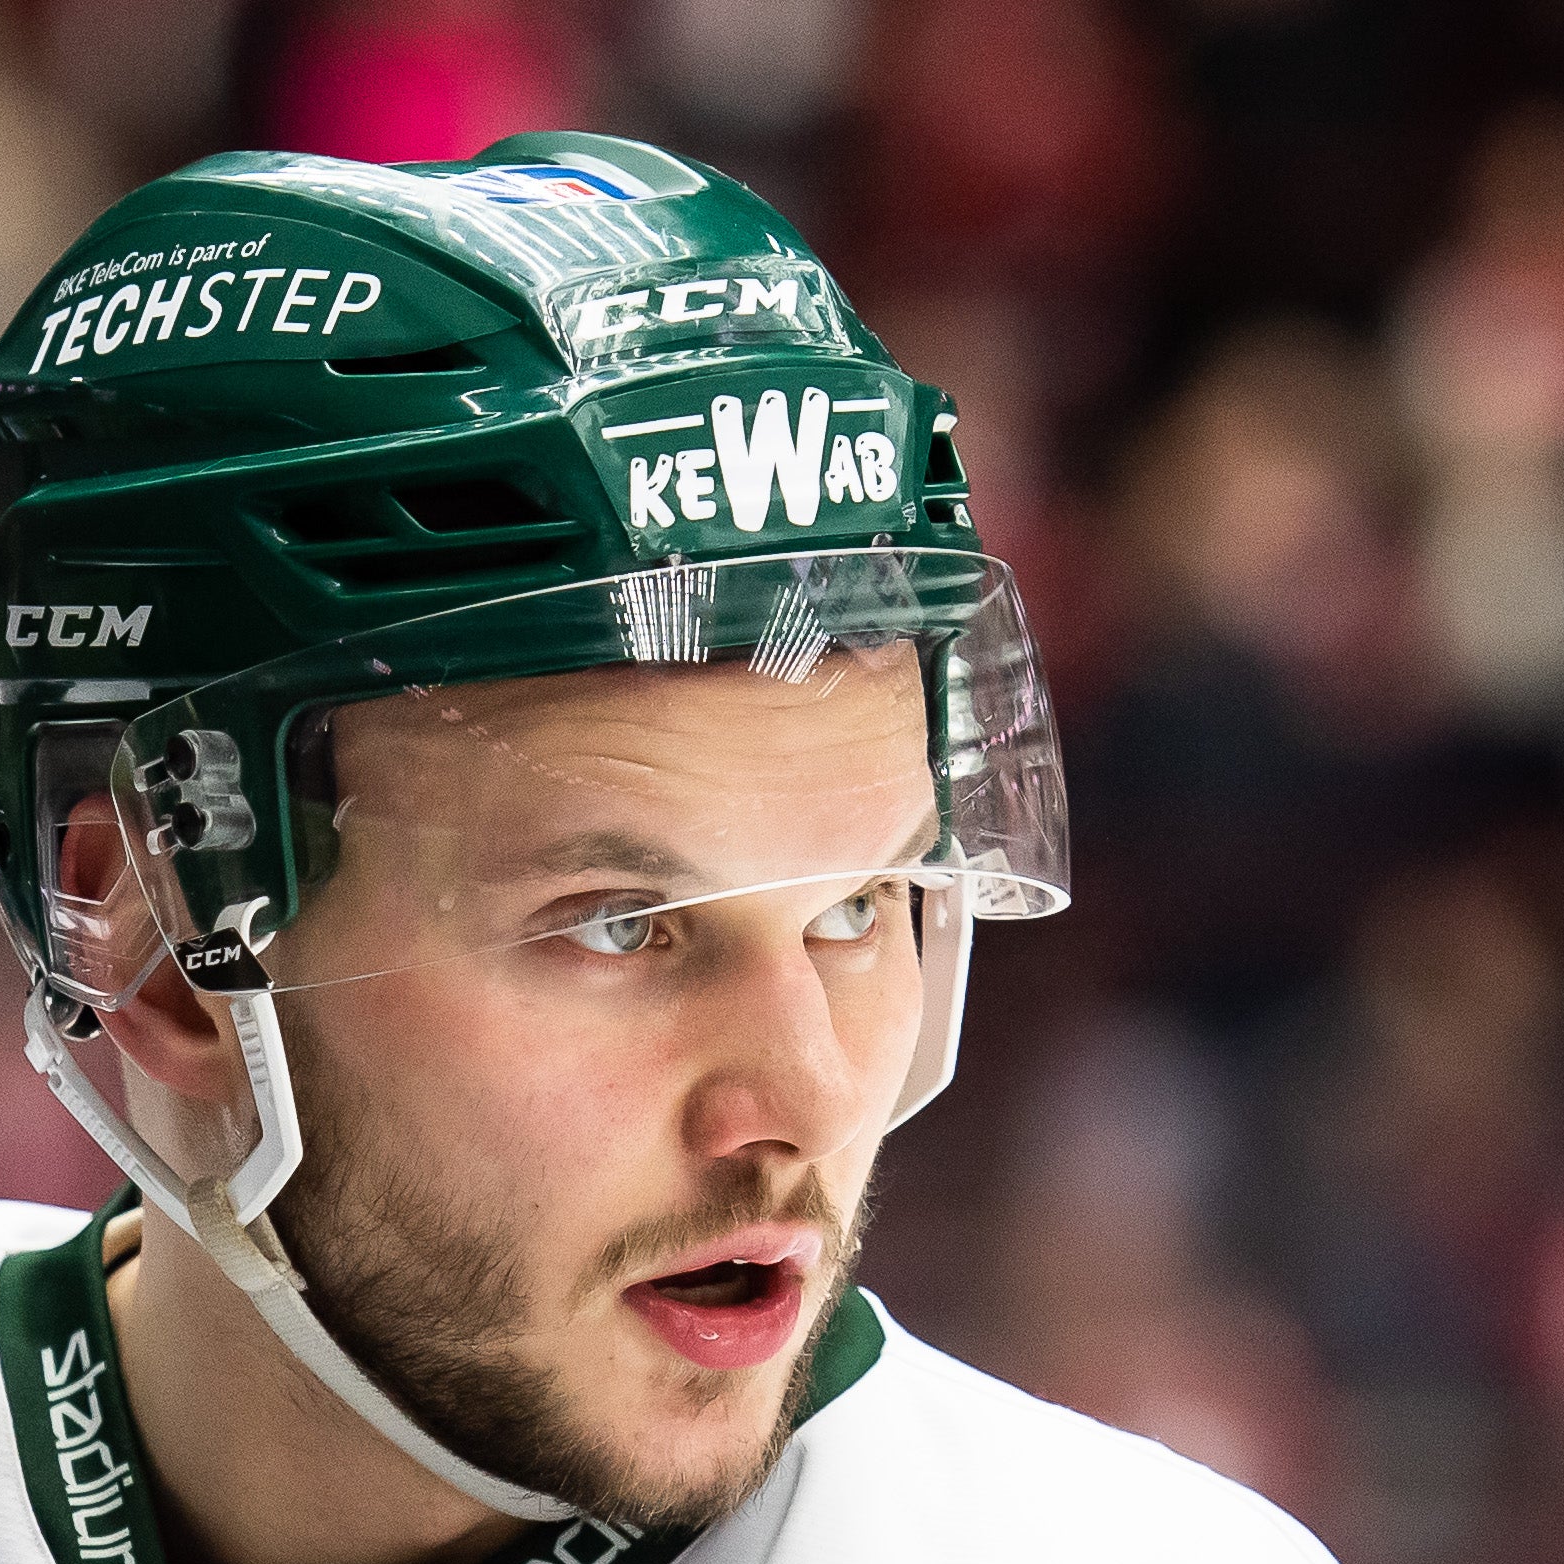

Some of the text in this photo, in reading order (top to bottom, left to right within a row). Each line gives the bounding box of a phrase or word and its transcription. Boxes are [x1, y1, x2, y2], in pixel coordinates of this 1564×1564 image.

[88, 251, 163, 288] TeleCom
[168, 243, 188, 266] is
[187, 237, 239, 270] part
[240, 232, 272, 257] of
[28, 268, 382, 375] TECHSTEP
[571, 278, 799, 341] CCM
[5, 605, 153, 647] CCM
[185, 944, 242, 970] CCM
